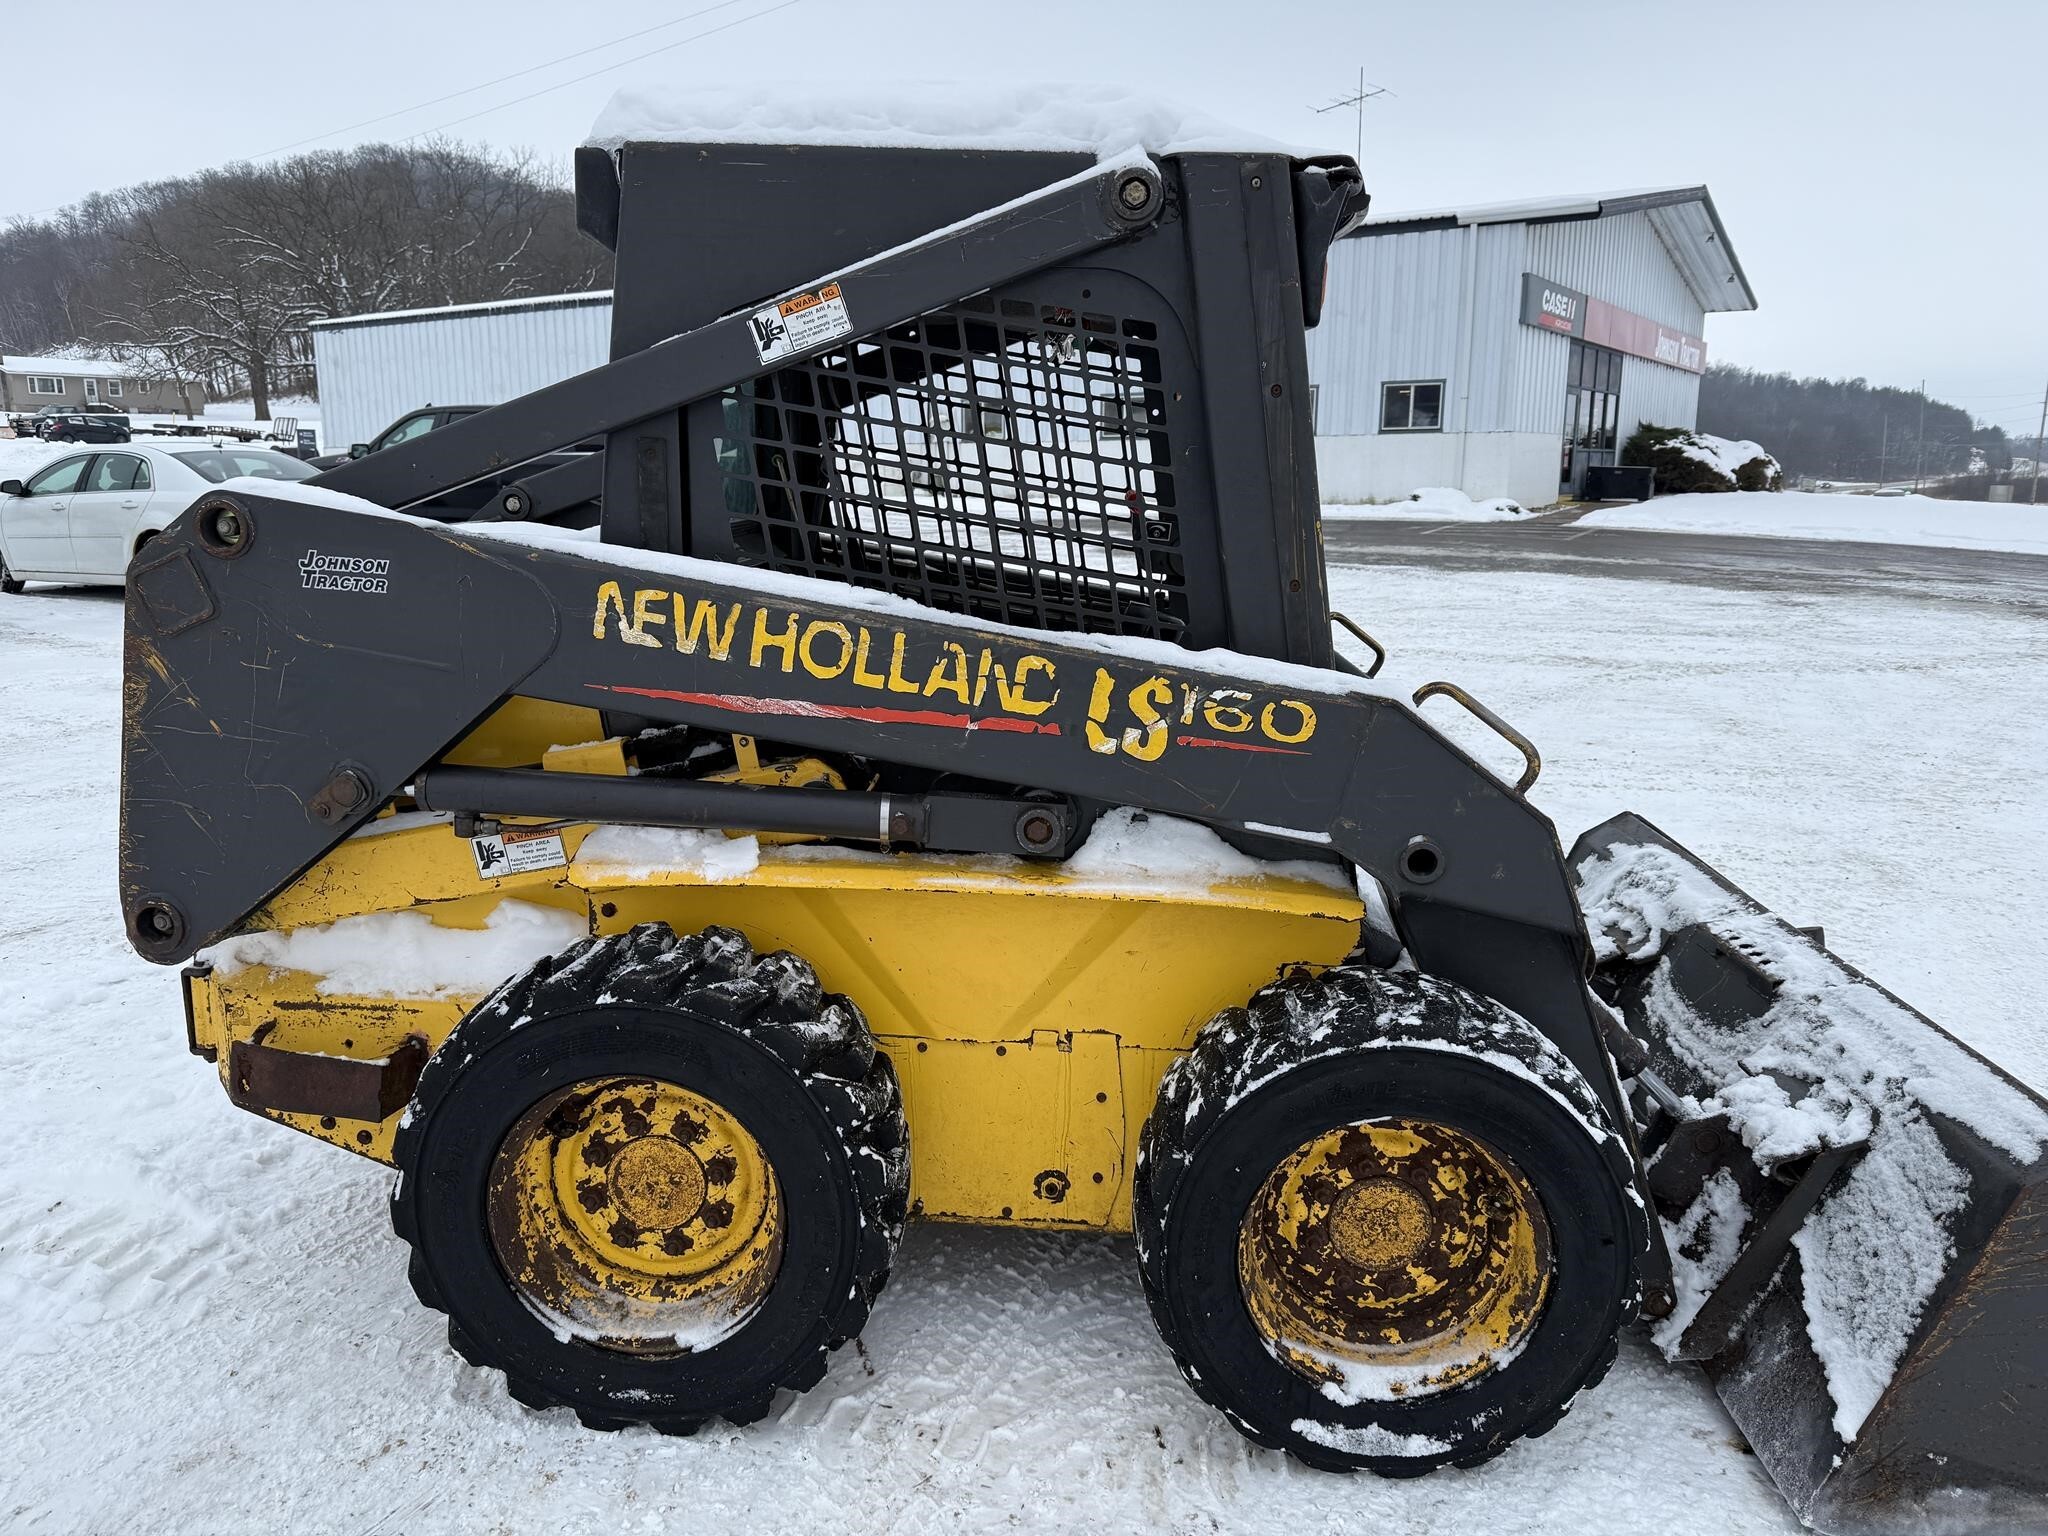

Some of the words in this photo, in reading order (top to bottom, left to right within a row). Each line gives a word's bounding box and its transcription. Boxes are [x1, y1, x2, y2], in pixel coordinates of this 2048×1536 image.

[794, 289, 835, 308] WARNNG
[796, 311, 813, 320] PINCH
[298, 549, 390, 574] JOHNSON
[301, 568, 388, 593] TRACTOR
[593, 581, 742, 661] NEW
[749, 607, 1061, 715] HOLLAND
